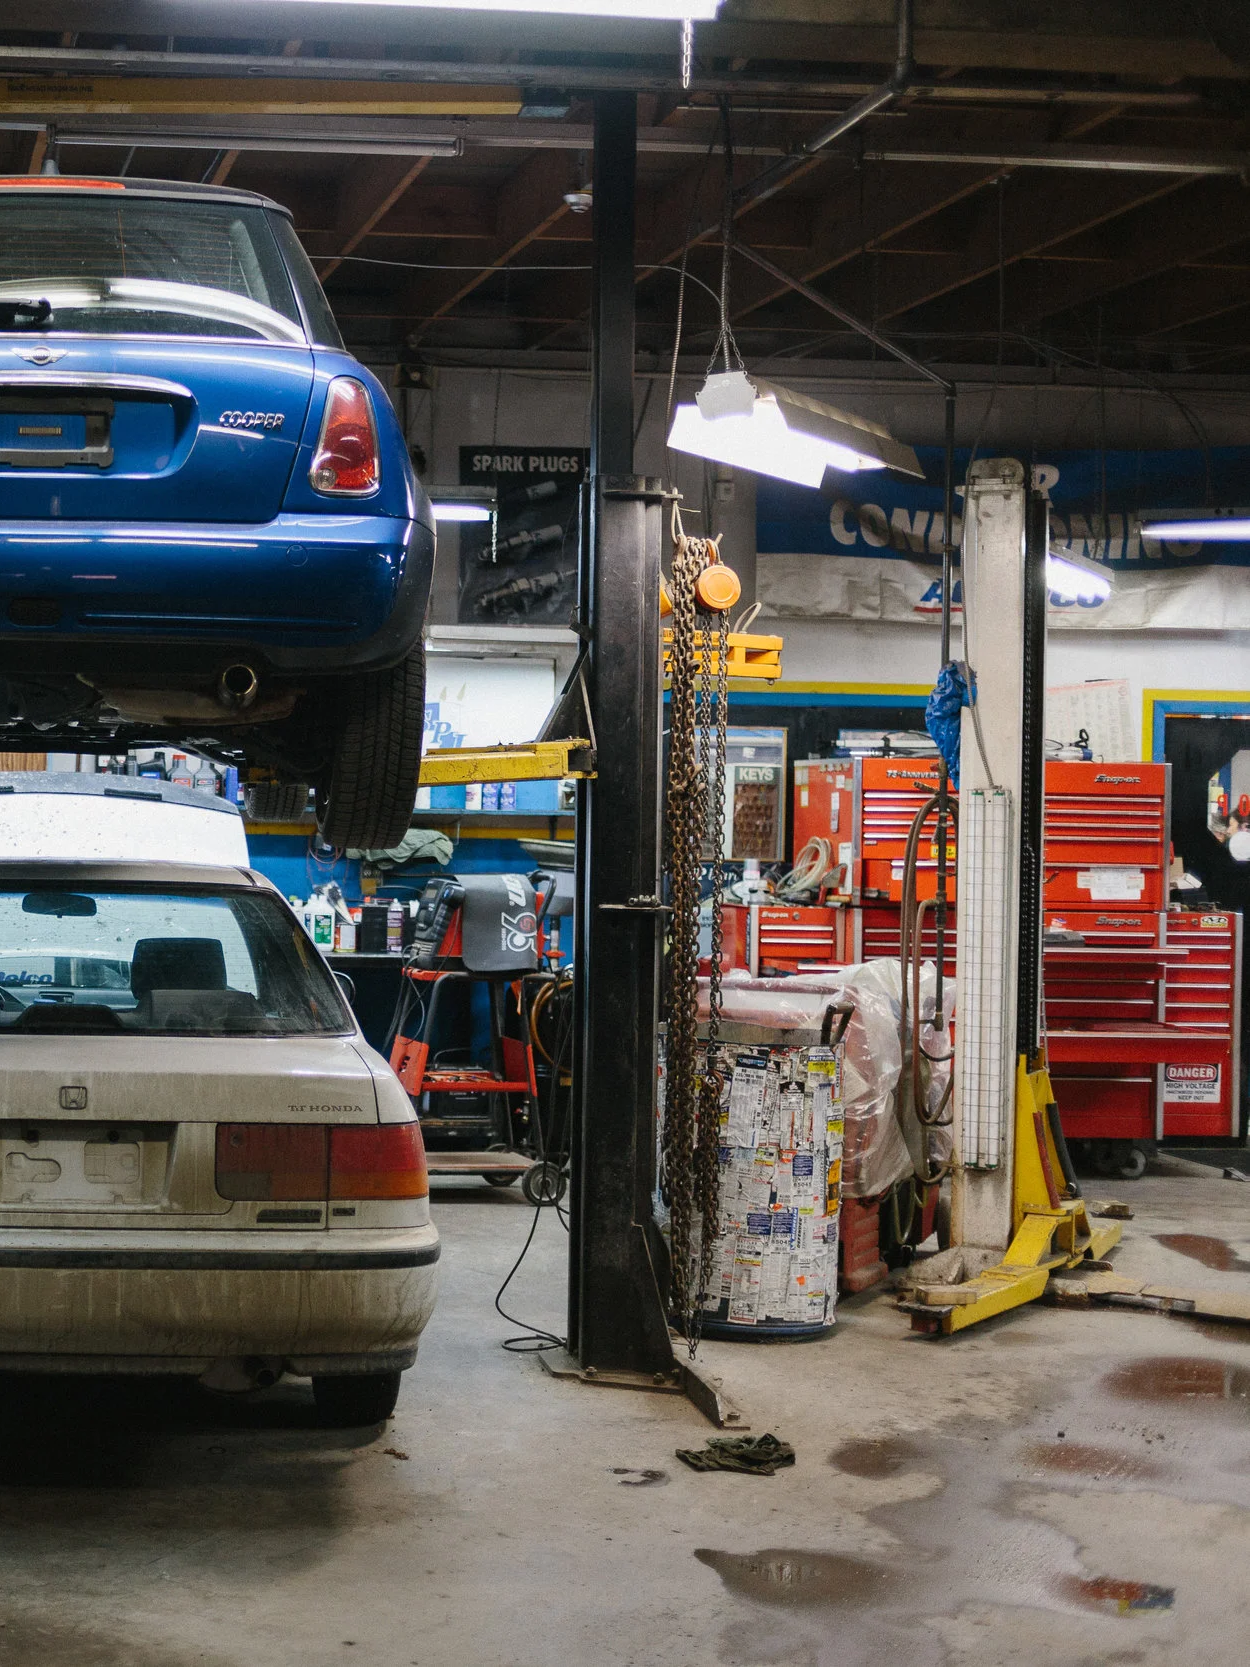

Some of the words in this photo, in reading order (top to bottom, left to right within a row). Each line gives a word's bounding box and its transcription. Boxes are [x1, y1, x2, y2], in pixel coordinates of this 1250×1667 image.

[219, 410, 285, 429] COOPER
[473, 456, 524, 471] SPARK
[529, 456, 578, 472] PLUGS
[740, 768, 774, 780] KEYS
[1094, 774, 1141, 785] Snap-on
[1095, 916, 1142, 928] Snap-on
[1170, 1067, 1213, 1077] DANGER
[1186, 1082, 1215, 1090] VOLTAGE
